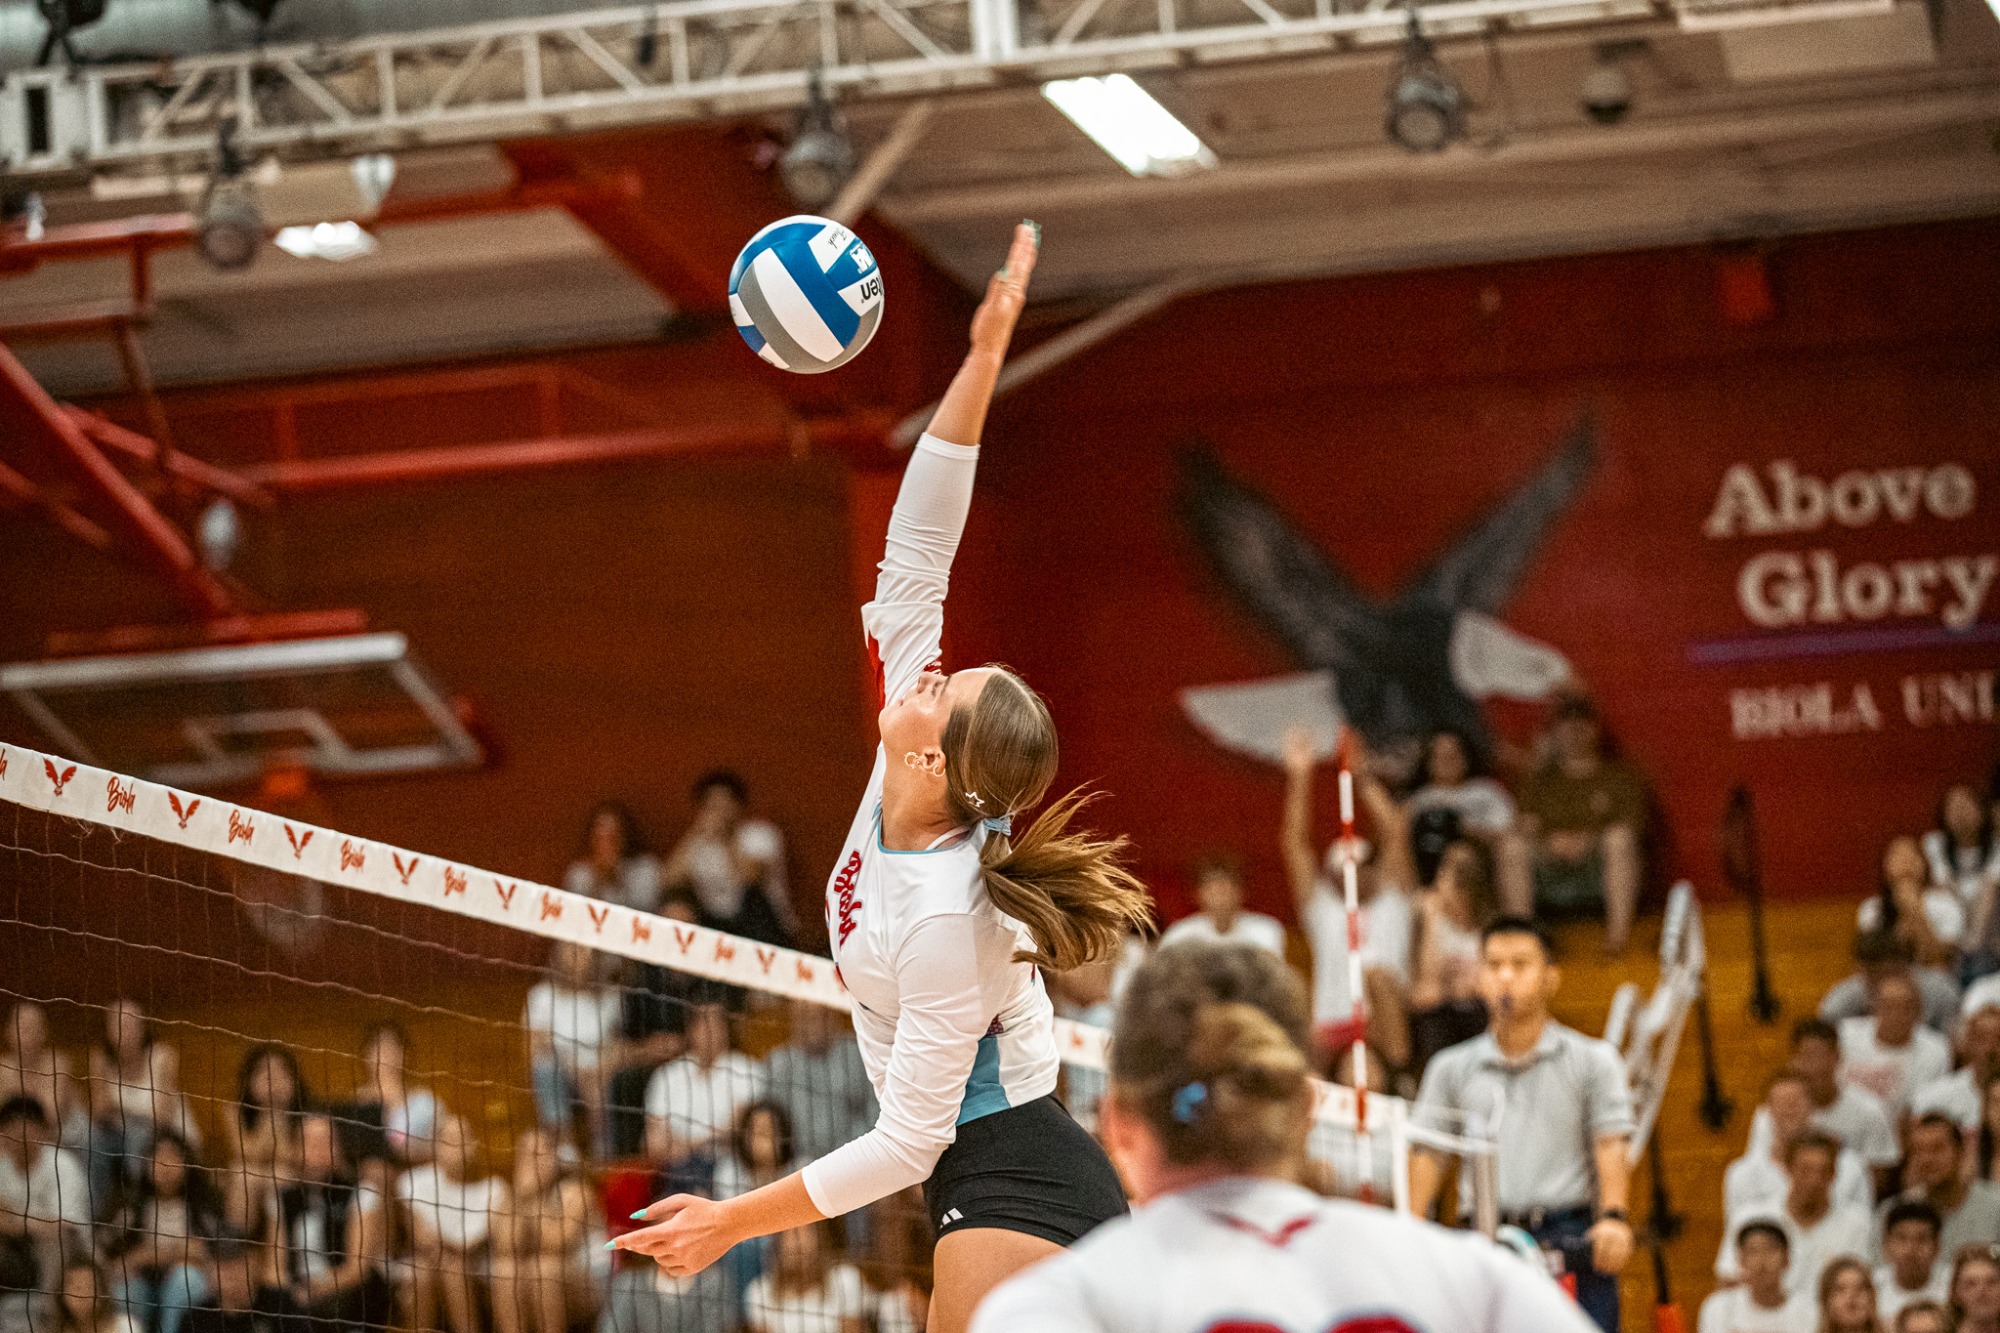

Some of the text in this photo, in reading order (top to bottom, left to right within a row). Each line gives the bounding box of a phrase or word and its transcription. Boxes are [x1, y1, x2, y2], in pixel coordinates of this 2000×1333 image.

[1706, 461, 1976, 537] Above
[1738, 551, 1998, 634] Glory
[107, 776, 136, 815] Biola
